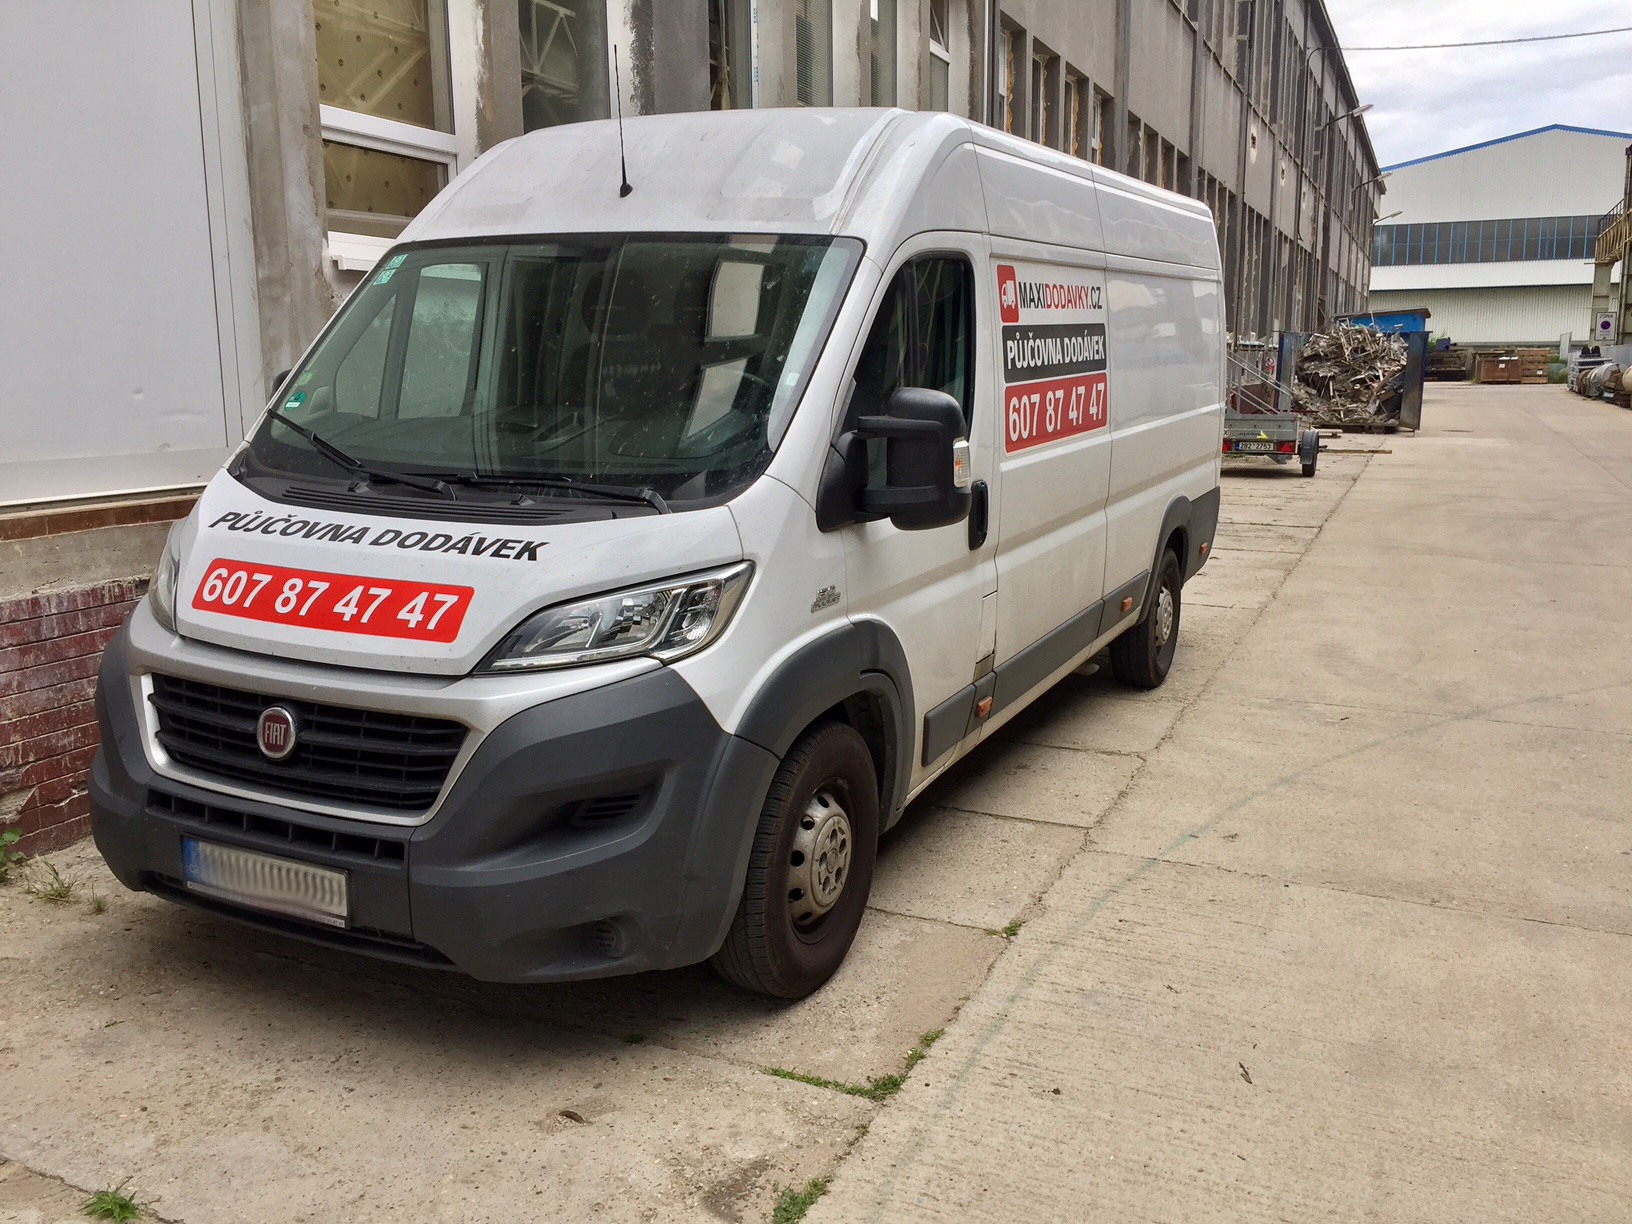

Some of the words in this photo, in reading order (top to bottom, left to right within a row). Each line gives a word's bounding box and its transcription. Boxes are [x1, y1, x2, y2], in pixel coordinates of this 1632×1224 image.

[1018, 281, 1103, 310] MAXIDODAVKY.CZ
[1007, 332, 1063, 370] PŮJČOVNA
[1064, 329, 1105, 362] DODÁVEK
[1008, 394, 1040, 441] 607
[1045, 389, 1064, 433] 87
[1068, 386, 1085, 426] 47
[1089, 382, 1105, 421] 47
[208, 510, 372, 546] PŮJČOVNA
[368, 529, 550, 562] DODÁVEK
[202, 567, 273, 608] 607
[274, 578, 330, 617] 87
[333, 585, 393, 623] 47
[397, 594, 460, 631] 47
[264, 721, 287, 745] FIAT
